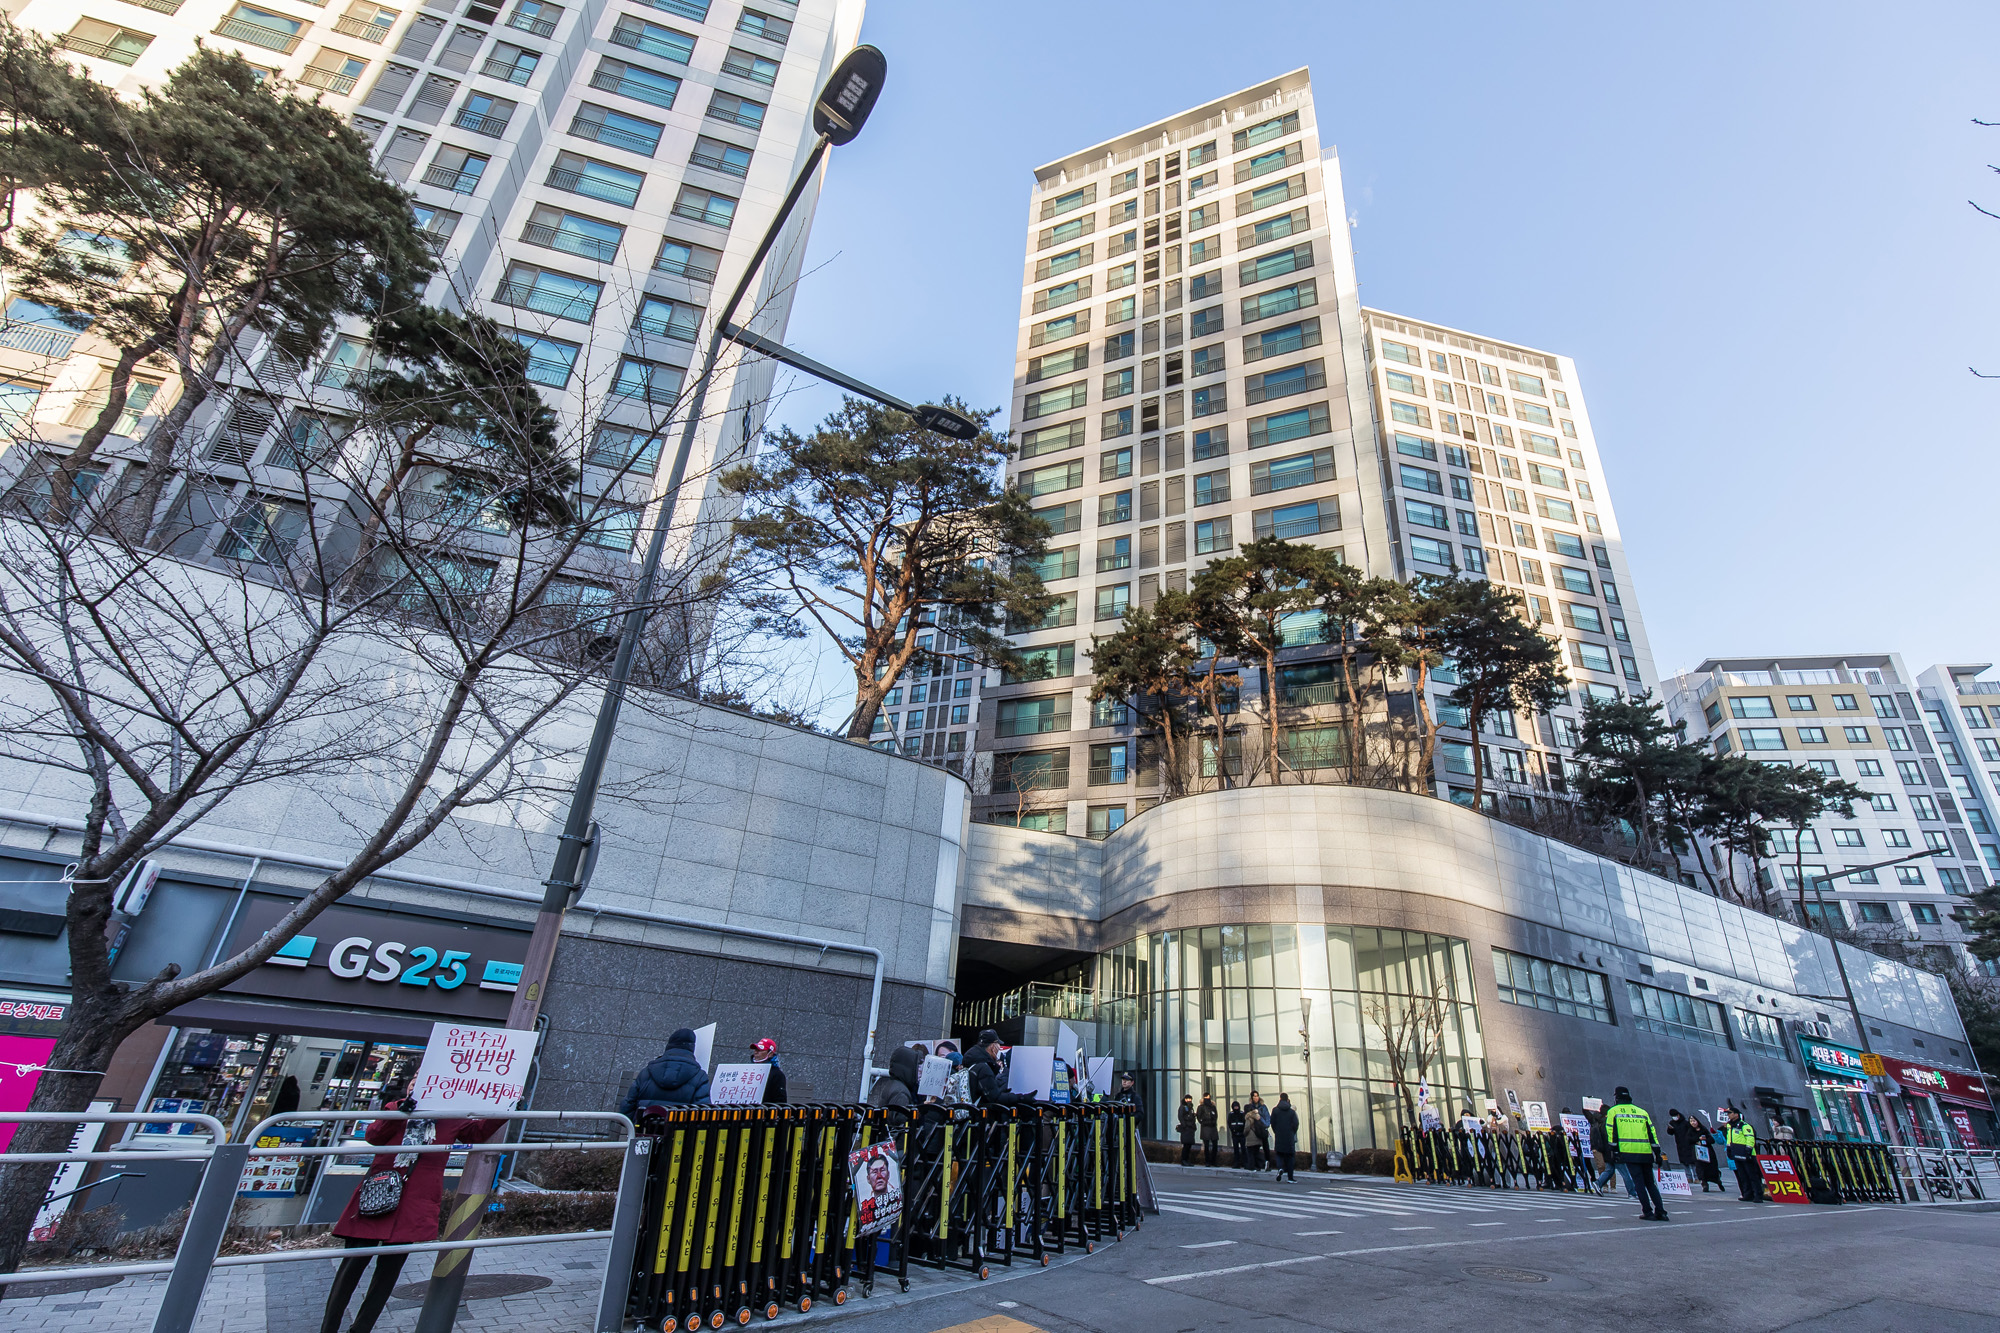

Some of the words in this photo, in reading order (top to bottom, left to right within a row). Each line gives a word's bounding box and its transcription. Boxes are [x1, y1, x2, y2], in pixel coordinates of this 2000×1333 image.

[328, 936, 472, 990] GS25
[0, 1001, 65, 1019] 모성재료
[444, 1028, 508, 1050] 음란수괴
[450, 1048, 517, 1076] 행번방
[692, 1154, 703, 1208] POLICE
[738, 1152, 747, 1204] POLICE
[793, 1150, 801, 1200] POLICE
[1760, 1159, 1795, 1175] 탄핵
[1768, 1181, 1803, 1196] 기각
[684, 1219, 692, 1256] LINE
[731, 1218, 739, 1251] LINE
